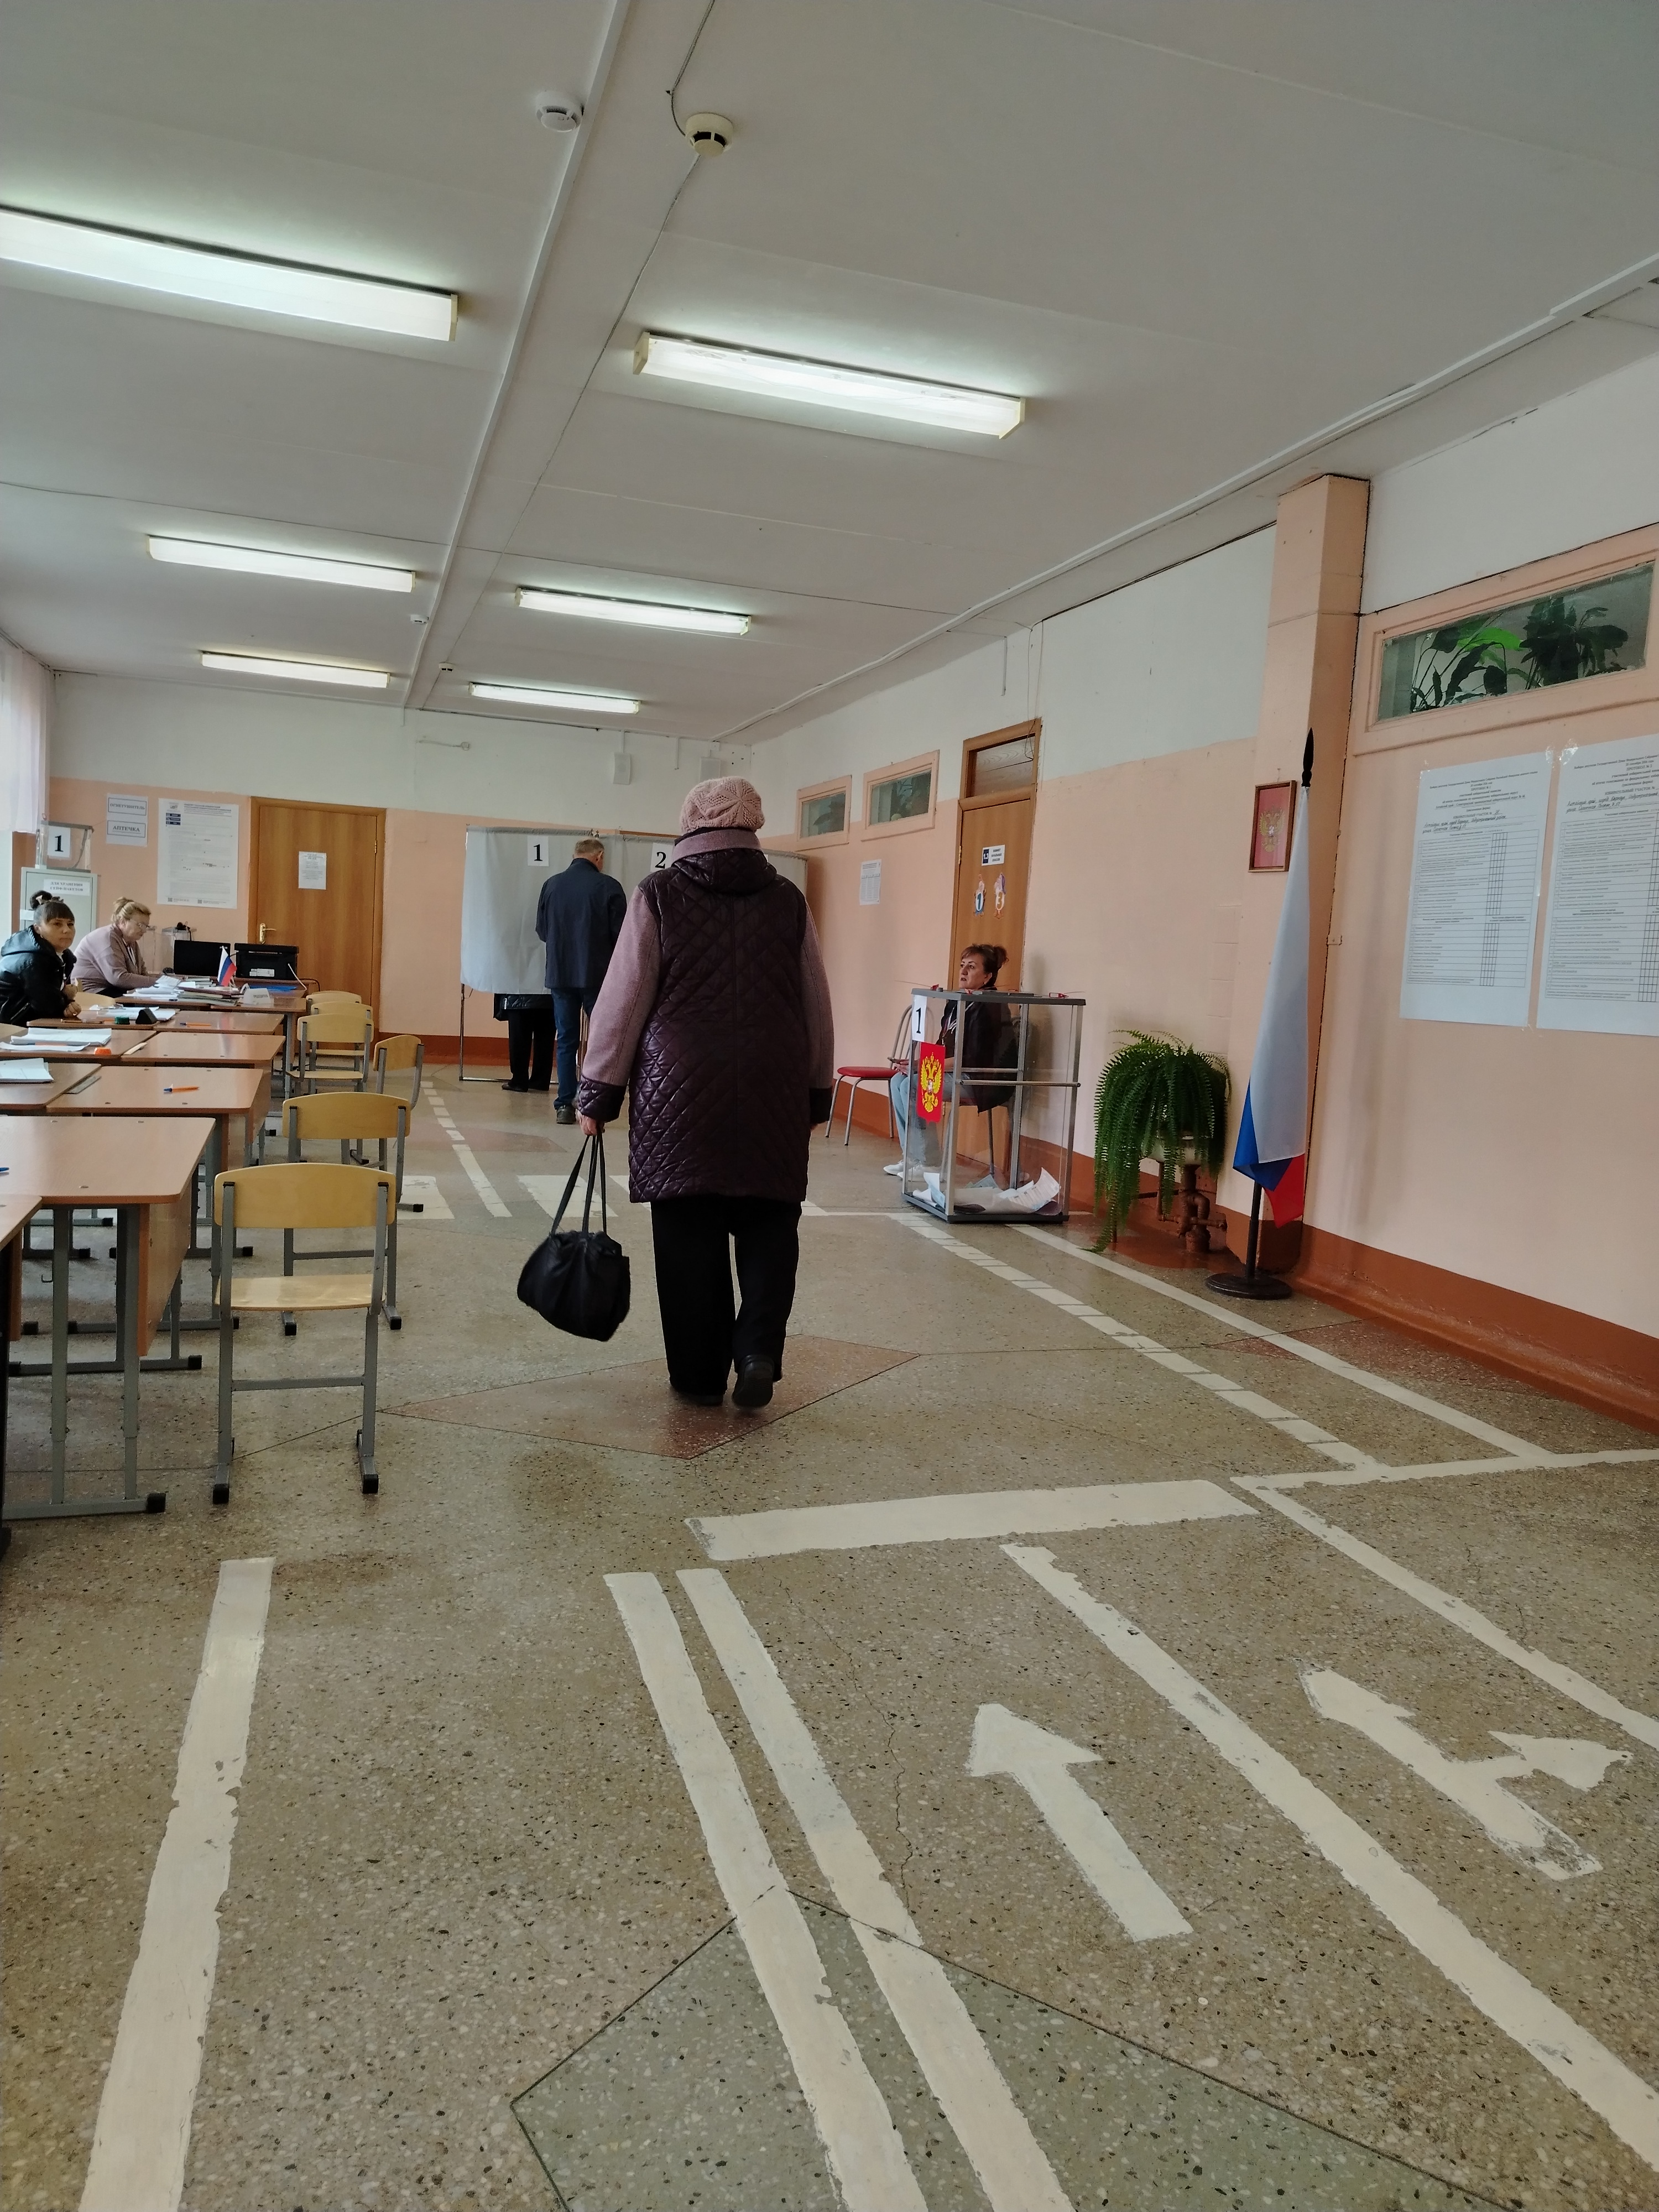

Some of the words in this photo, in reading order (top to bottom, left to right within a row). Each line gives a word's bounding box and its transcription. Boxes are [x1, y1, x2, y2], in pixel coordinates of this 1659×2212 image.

[55, 835, 64, 852] 1
[534, 844, 543, 862] 1
[655, 852, 666, 869] 2
[977, 893, 982, 910] 1
[997, 891, 1003, 909] 3
[916, 1007, 921, 1034] 1
